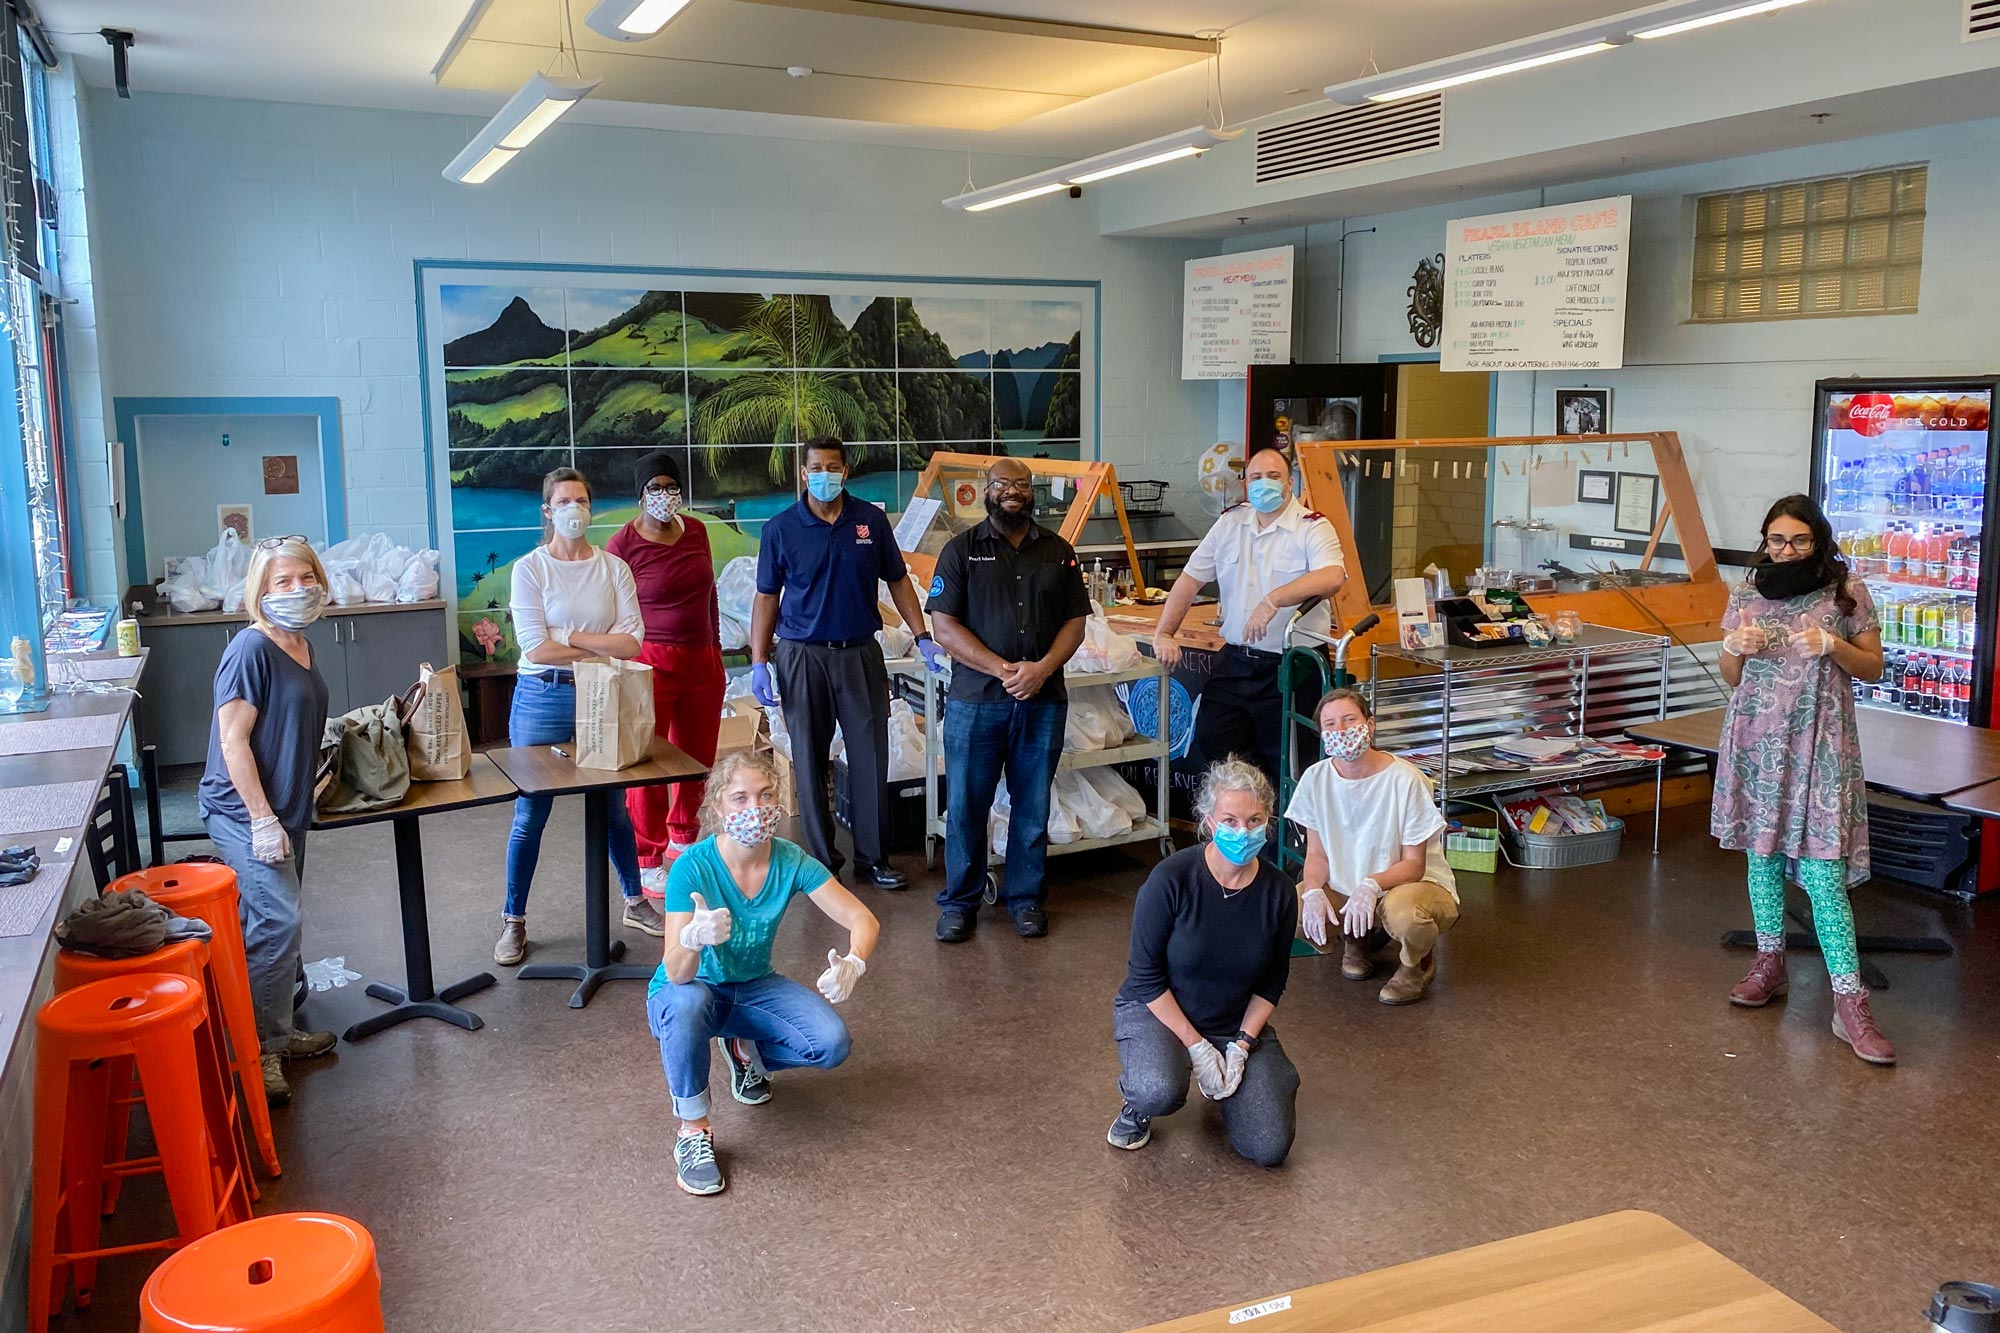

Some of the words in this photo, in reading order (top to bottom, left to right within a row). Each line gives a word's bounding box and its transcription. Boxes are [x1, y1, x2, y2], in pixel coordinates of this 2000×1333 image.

[1463, 225, 1510, 242] PEARL
[1594, 244, 1619, 253] DRINKS
[1553, 318, 1592, 327] SPECIALS
[1481, 360, 1502, 368] ABOUT
[1849, 404, 1893, 419] Coca-Cola
[1899, 417, 1923, 426] ICE
[1930, 417, 1968, 427] COLD
